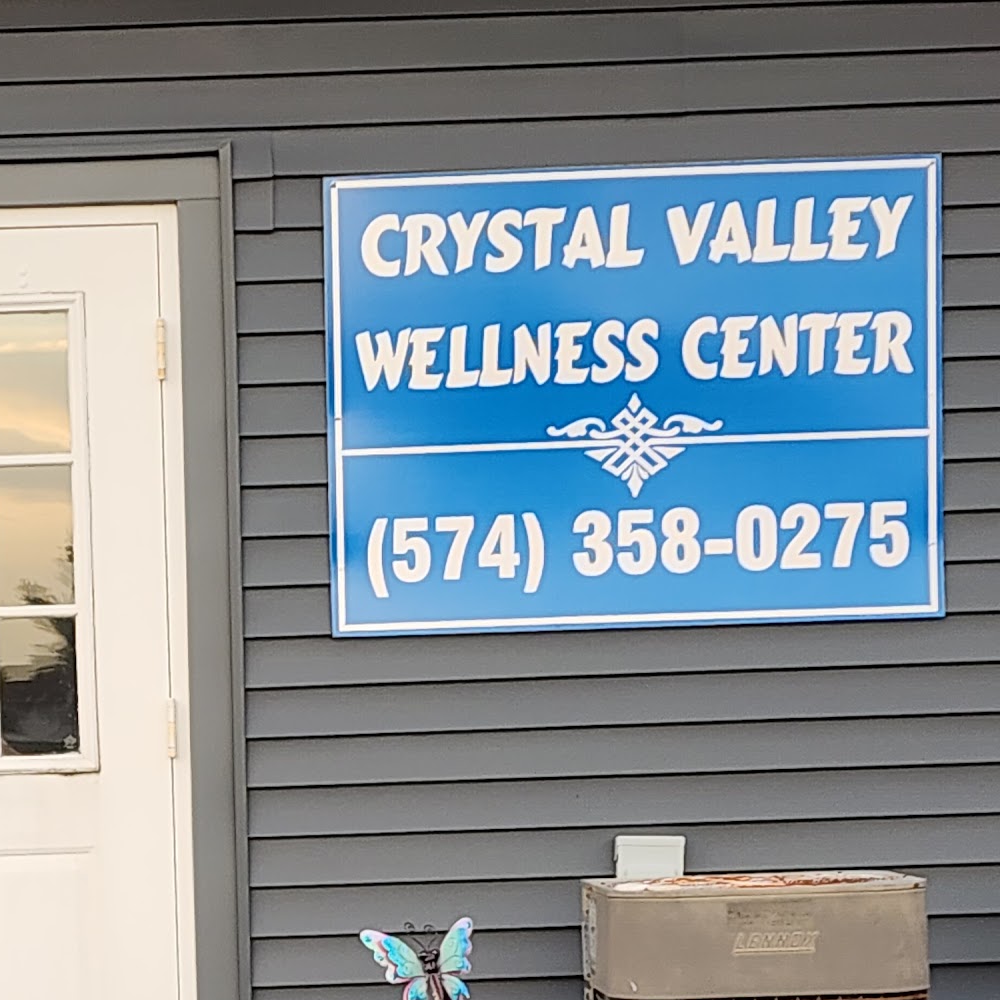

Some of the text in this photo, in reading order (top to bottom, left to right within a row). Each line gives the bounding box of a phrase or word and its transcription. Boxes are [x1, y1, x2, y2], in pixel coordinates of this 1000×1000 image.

[361, 195, 914, 277] CRYSTAL VALLEY
[355, 311, 914, 392] WELLNESS CENTER
[367, 501, 910, 598] (574) 358-0275
[734, 930, 820, 951] LENNOX
